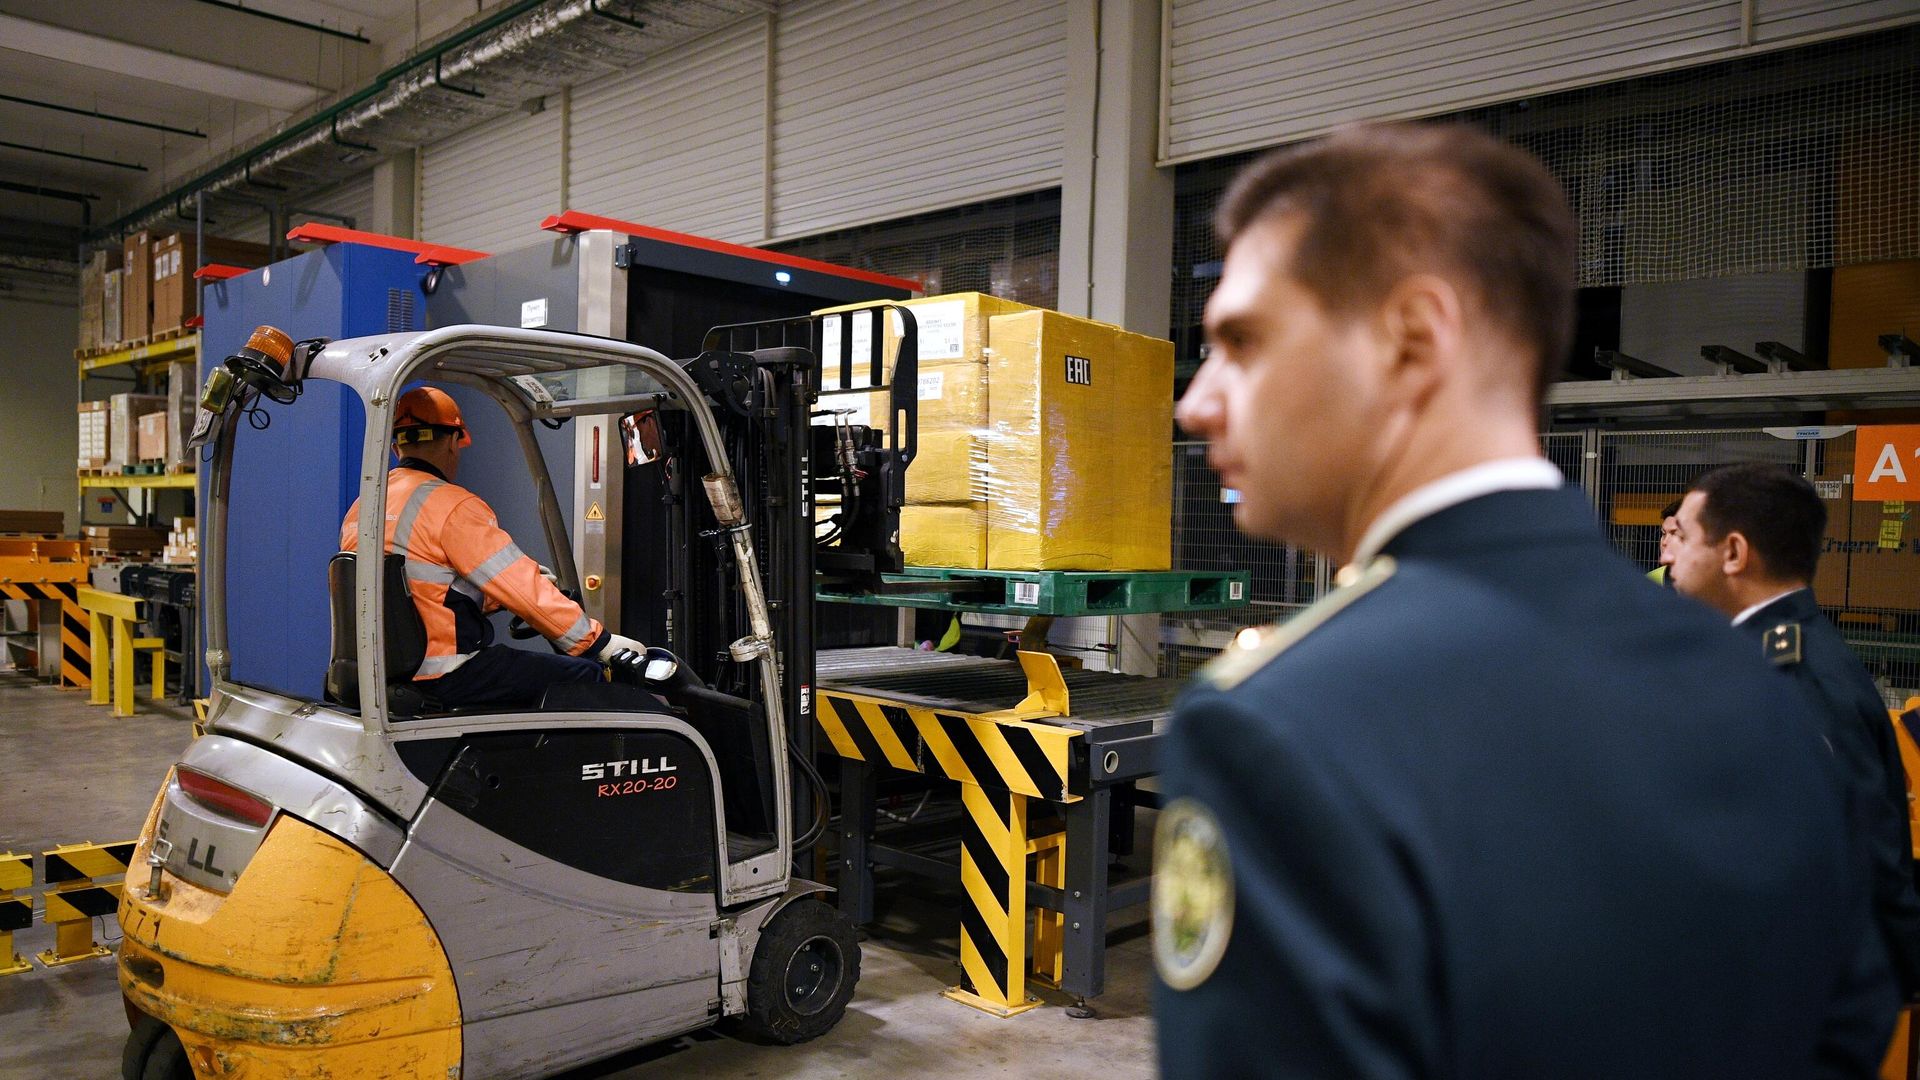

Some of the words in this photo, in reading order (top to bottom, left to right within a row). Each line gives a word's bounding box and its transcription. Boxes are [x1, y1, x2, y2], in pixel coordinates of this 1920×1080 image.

[1067, 356, 1090, 385] EAC
[1867, 443, 1920, 483] A
[581, 756, 677, 781] STILL
[597, 776, 677, 798] RX20-20
